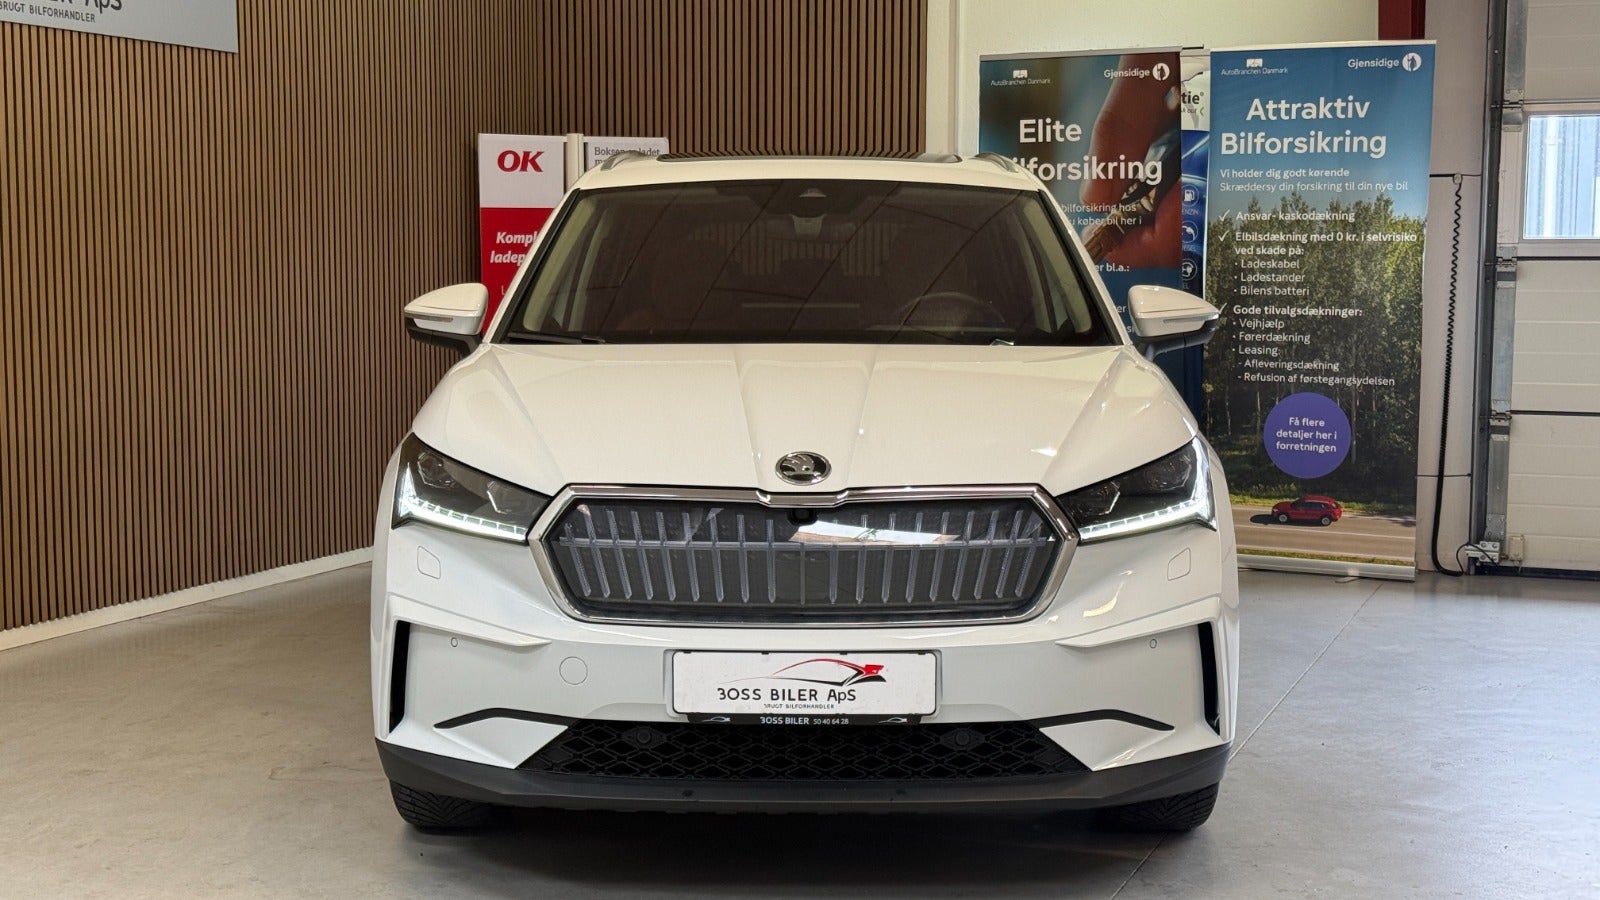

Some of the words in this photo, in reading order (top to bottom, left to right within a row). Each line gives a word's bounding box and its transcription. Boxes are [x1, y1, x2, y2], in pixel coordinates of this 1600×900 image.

[29, 5, 96, 23] BILFORHANDLER
[1347, 58, 1399, 69] Gjensidige
[1104, 67, 1151, 79] Gjensidige
[1246, 95, 1370, 121] Attraktiv
[1019, 118, 1082, 143] Elite
[1221, 130, 1387, 159] Bilforsikring
[497, 150, 544, 173] OK
[1220, 169, 1230, 178] Vi
[1232, 169, 1263, 178] holder
[1266, 168, 1282, 180] dig
[1283, 169, 1306, 179] godt
[1308, 168, 1350, 178] kørende
[1219, 182, 1277, 193] Skræddersy
[1279, 182, 1294, 191] din
[1296, 182, 1342, 193] forsikring
[1345, 182, 1356, 191] til
[1358, 182, 1373, 191] din
[1375, 183, 1393, 193] nye
[1395, 181, 1409, 191] bil
[1119, 203, 1137, 212] hos
[1078, 216, 1105, 226] køber
[1107, 216, 1118, 225] bil
[1120, 216, 1137, 225] her
[1139, 215, 1142, 225] i
[1235, 212, 1276, 221] Ansvar-
[1279, 211, 1355, 222] kaskodækning
[1235, 231, 1308, 243] Elbilsdækning
[1310, 232, 1333, 242] med
[1336, 232, 1343, 242] 0
[1345, 232, 1359, 242] kr.
[1361, 232, 1366, 242] i
[1367, 232, 1417, 242] selvrisiko
[1235, 246, 1254, 255] ved
[1256, 246, 1286, 255] skade
[1288, 245, 1304, 257] på:
[1106, 262, 1130, 272] bl.a.:
[1241, 259, 1300, 269] Ladeskabel
[1240, 272, 1305, 282] Ladestander
[1240, 286, 1272, 295] Bilens
[1275, 286, 1310, 296] batteri
[1233, 305, 1261, 315] Gode
[1264, 305, 1362, 318] tilvalgsdækninger:
[1239, 319, 1285, 330] Vejhjælp
[1239, 332, 1311, 345] Førerdækning
[1244, 360, 1340, 372] Afleveringsdækning
[1243, 373, 1286, 383] Refusion
[1288, 374, 1298, 383] af
[1299, 374, 1396, 388] førstegangsydelsen
[1288, 416, 1300, 426] Få
[1302, 417, 1325, 427] flere
[1276, 428, 1314, 441] detaljer
[1315, 430, 1331, 440] her
[1333, 430, 1337, 440] i
[1276, 441, 1337, 454] forretningen
[770, 688, 818, 701] BILER
[827, 688, 856, 704] ApS
[785, 716, 810, 725] BILER
